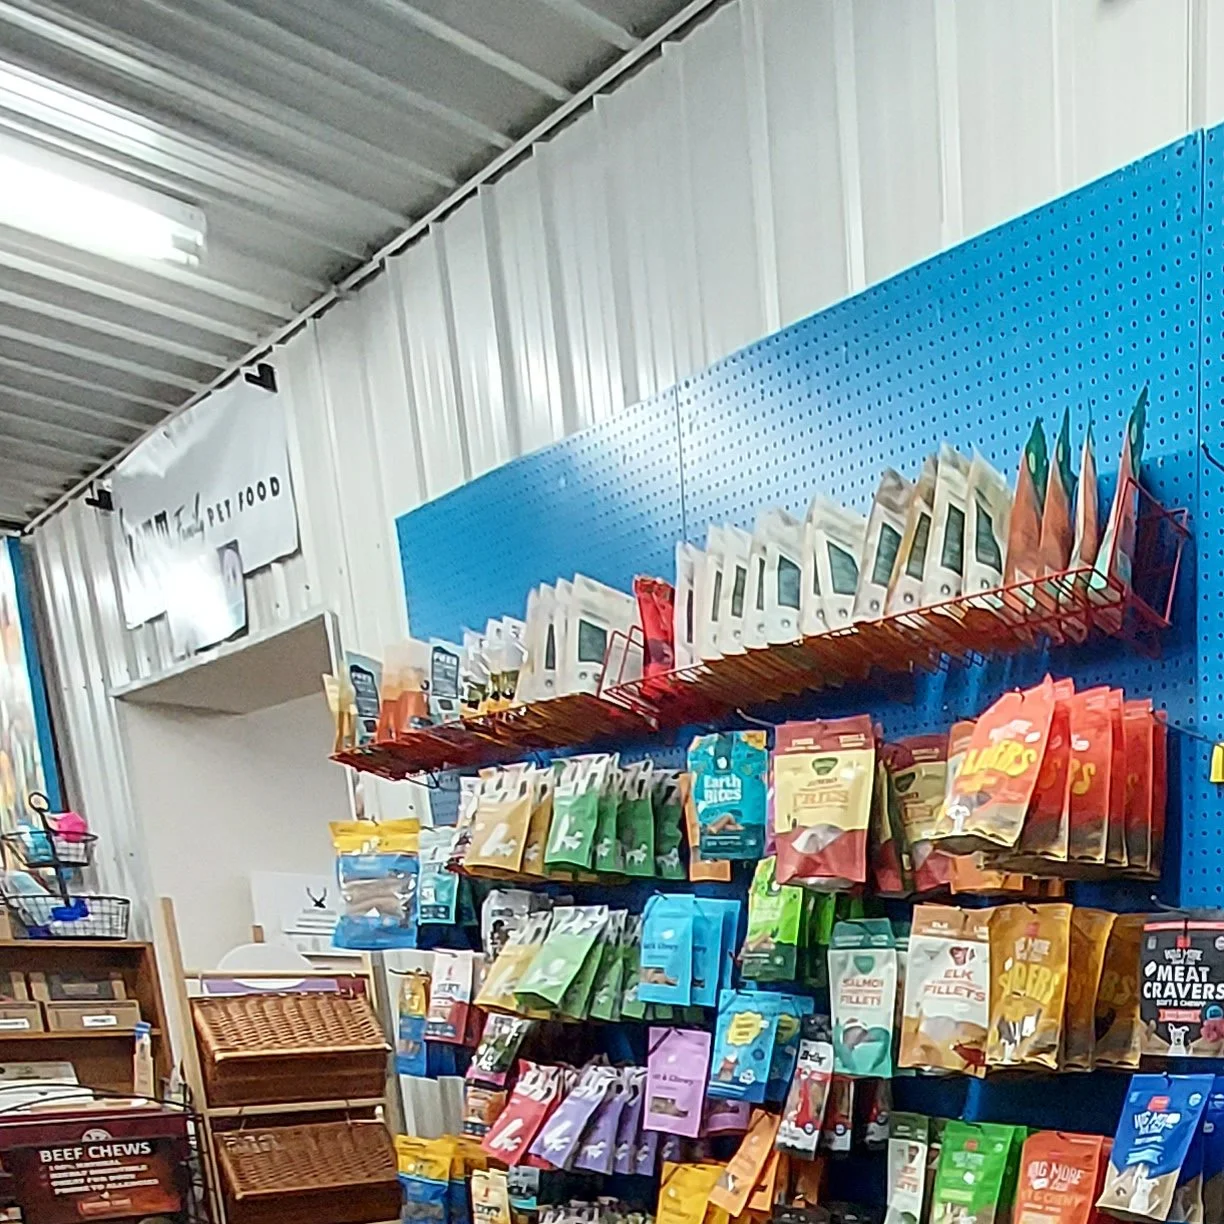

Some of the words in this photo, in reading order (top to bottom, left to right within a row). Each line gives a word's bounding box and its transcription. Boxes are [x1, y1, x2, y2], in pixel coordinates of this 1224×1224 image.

[206, 499, 232, 528] PET
[239, 476, 281, 513] FOOD
[703, 774, 741, 791] Earth
[703, 787, 742, 804] Bites
[944, 968, 975, 981] ELK
[1157, 966, 1210, 983] MEAT
[923, 983, 985, 1002] FILLETS
[39, 1147, 83, 1164] BEEF
[87, 1141, 152, 1160] CHEWS
[1050, 1162, 1085, 1185] MORE
